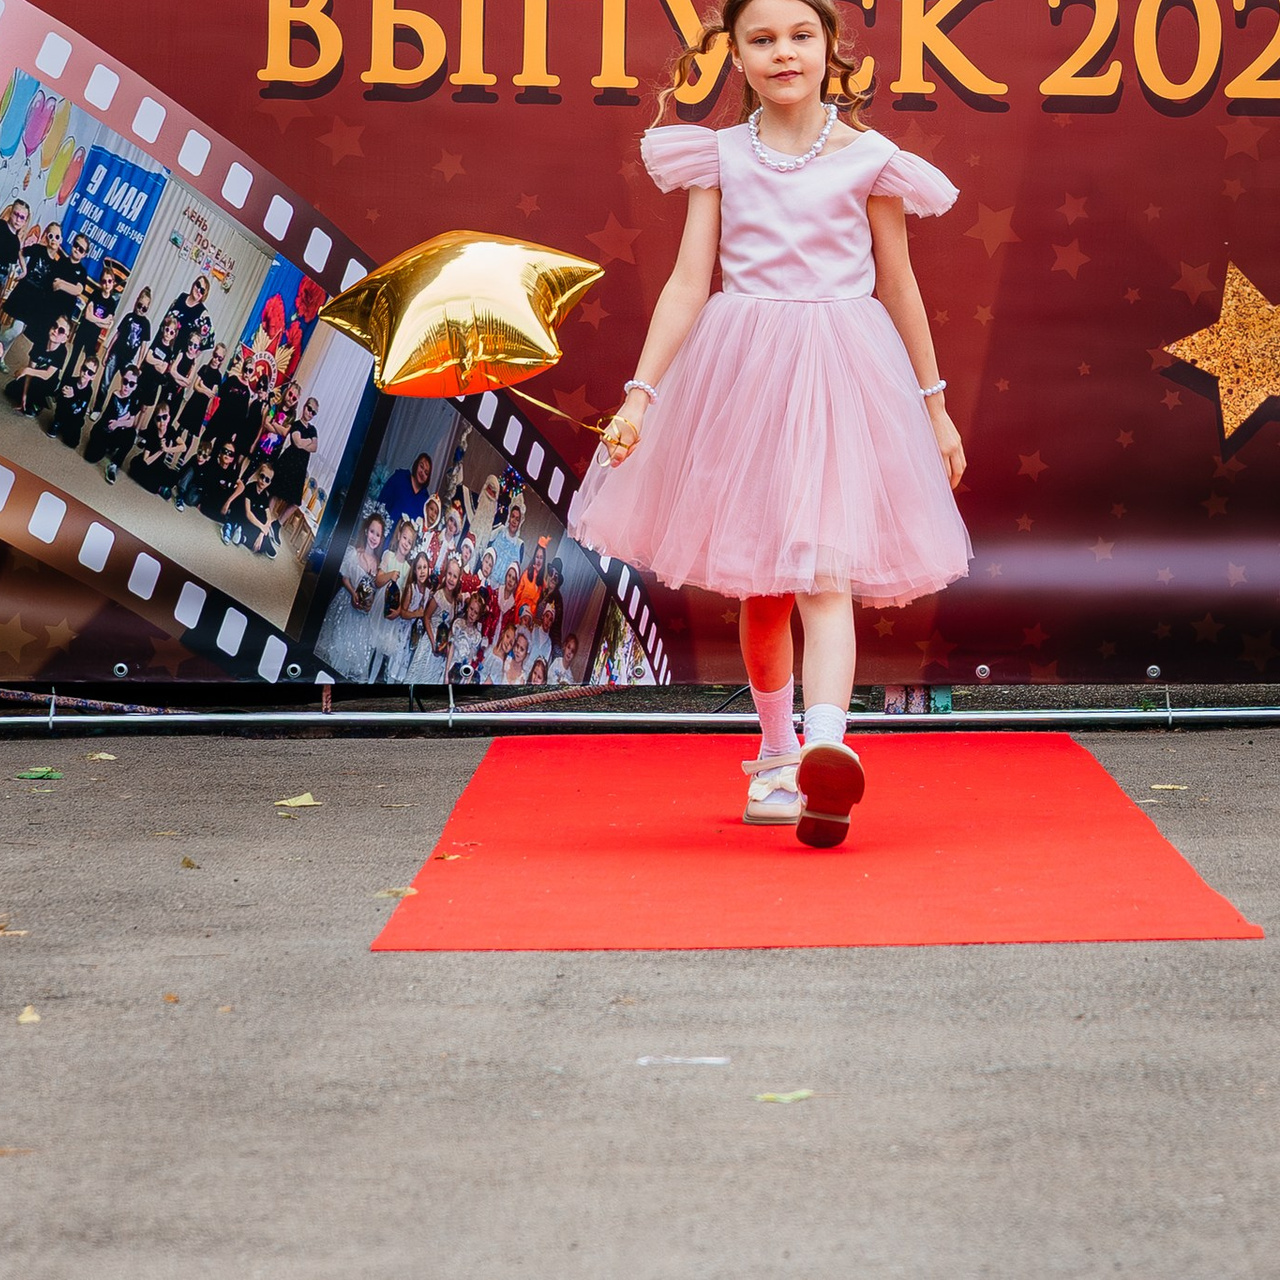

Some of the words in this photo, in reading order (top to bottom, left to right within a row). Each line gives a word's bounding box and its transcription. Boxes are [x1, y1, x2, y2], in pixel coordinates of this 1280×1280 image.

[70, 192, 80, 207] С
[77, 197, 104, 223] ДНЕМ
[86, 164, 108, 195] 9
[103, 176, 148, 222] МАЯ
[67, 230, 104, 262] ПДЫ!
[80, 219, 118, 251] ВЕЛИКОЙ
